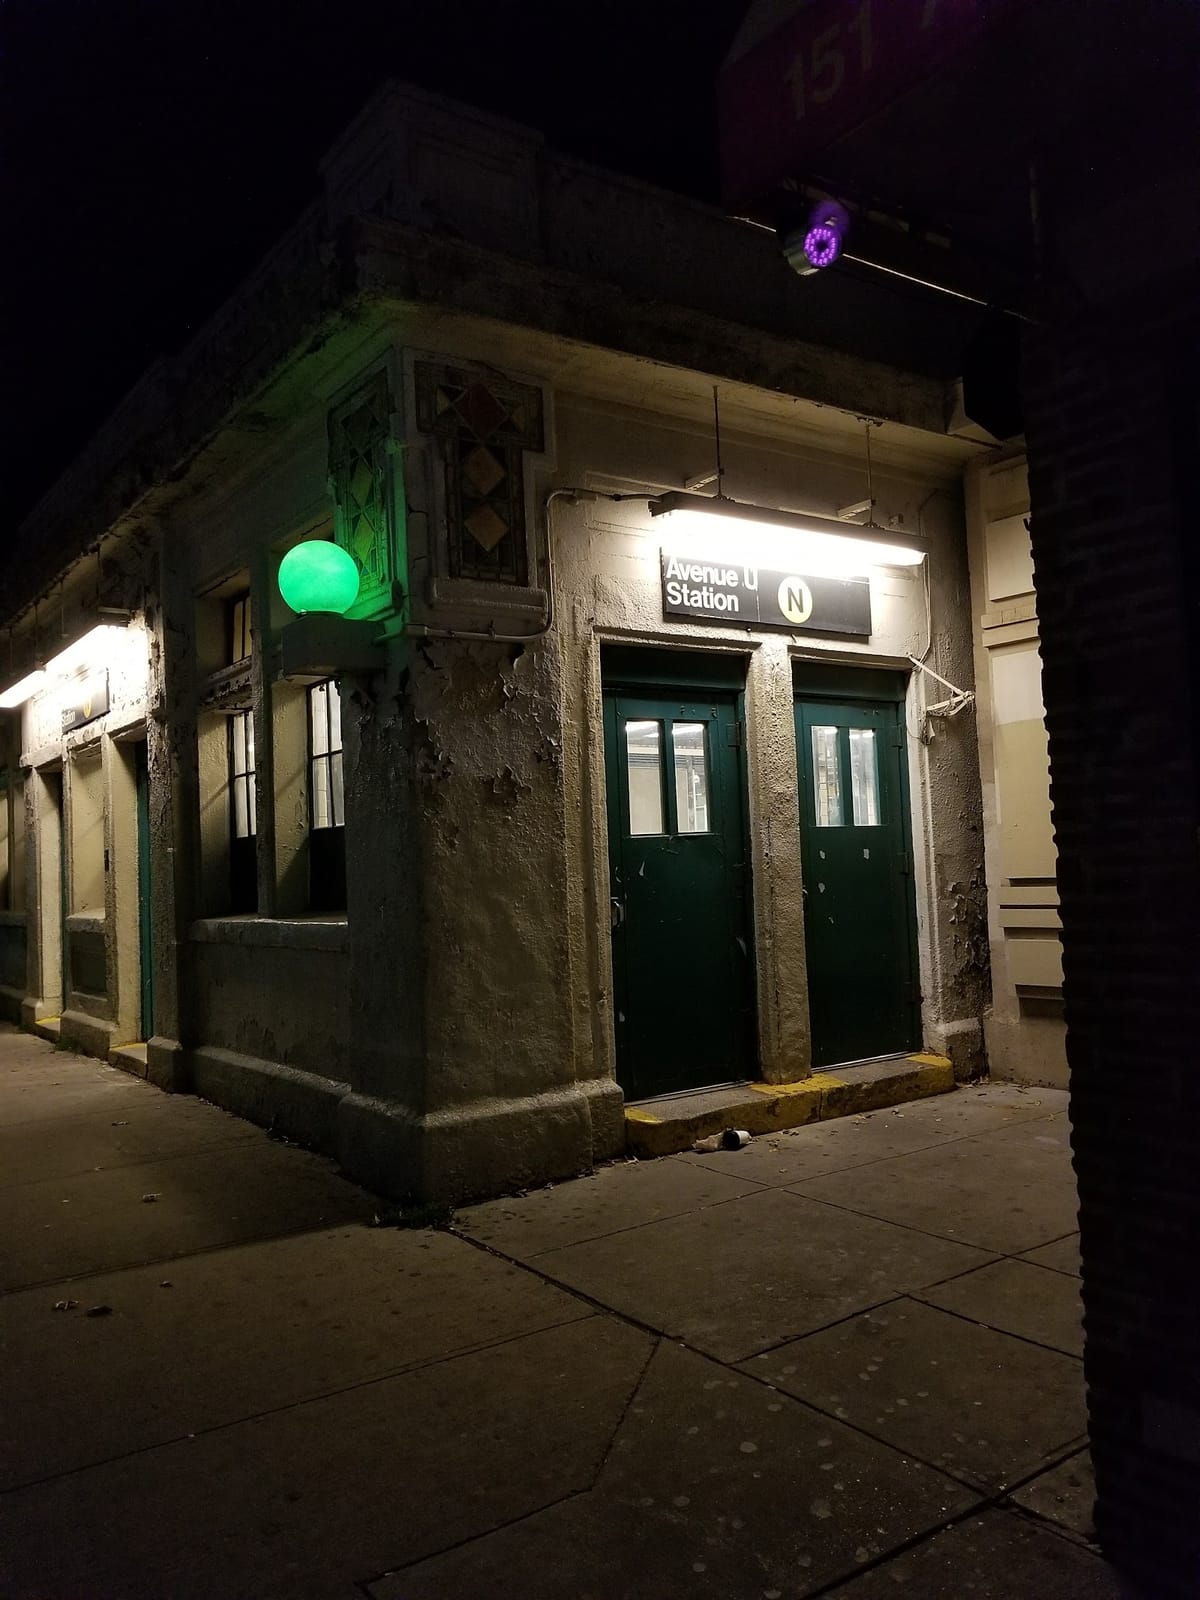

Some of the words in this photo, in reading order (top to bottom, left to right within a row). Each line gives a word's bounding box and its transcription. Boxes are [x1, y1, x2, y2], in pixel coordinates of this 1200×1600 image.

[783, 0, 874, 120] 151
[665, 557, 739, 588] Avenue
[742, 566, 759, 592] U
[665, 581, 740, 613] Station
[787, 586, 804, 613] N
